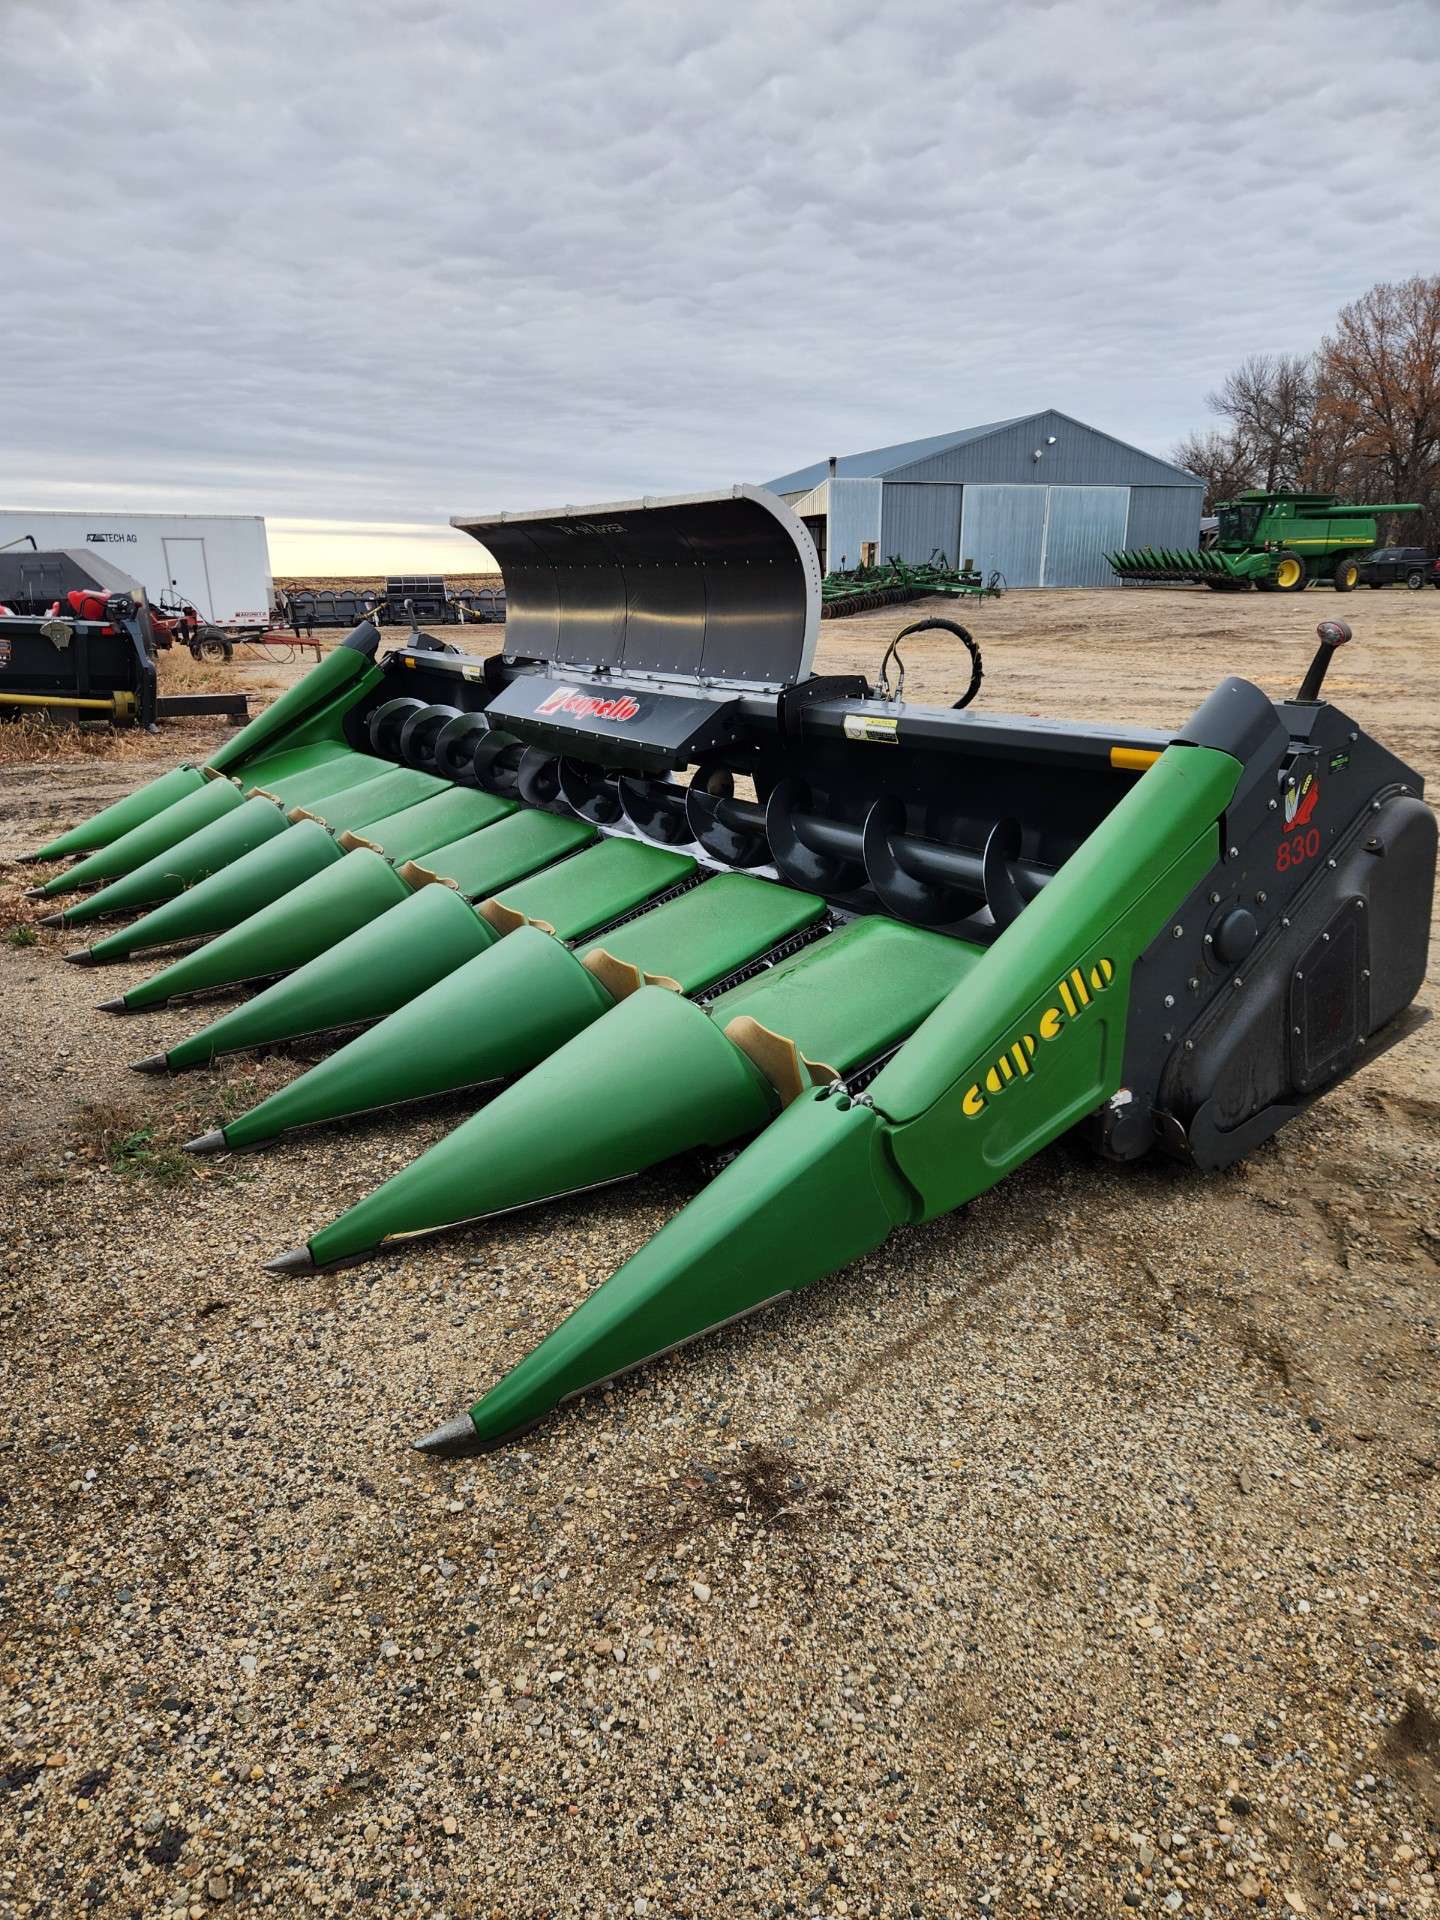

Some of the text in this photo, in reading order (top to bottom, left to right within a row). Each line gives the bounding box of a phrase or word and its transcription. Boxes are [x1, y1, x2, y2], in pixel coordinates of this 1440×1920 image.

[126, 533, 138, 543] AG
[1275, 826, 1321, 872] 830
[962, 958, 1114, 1117] capello
